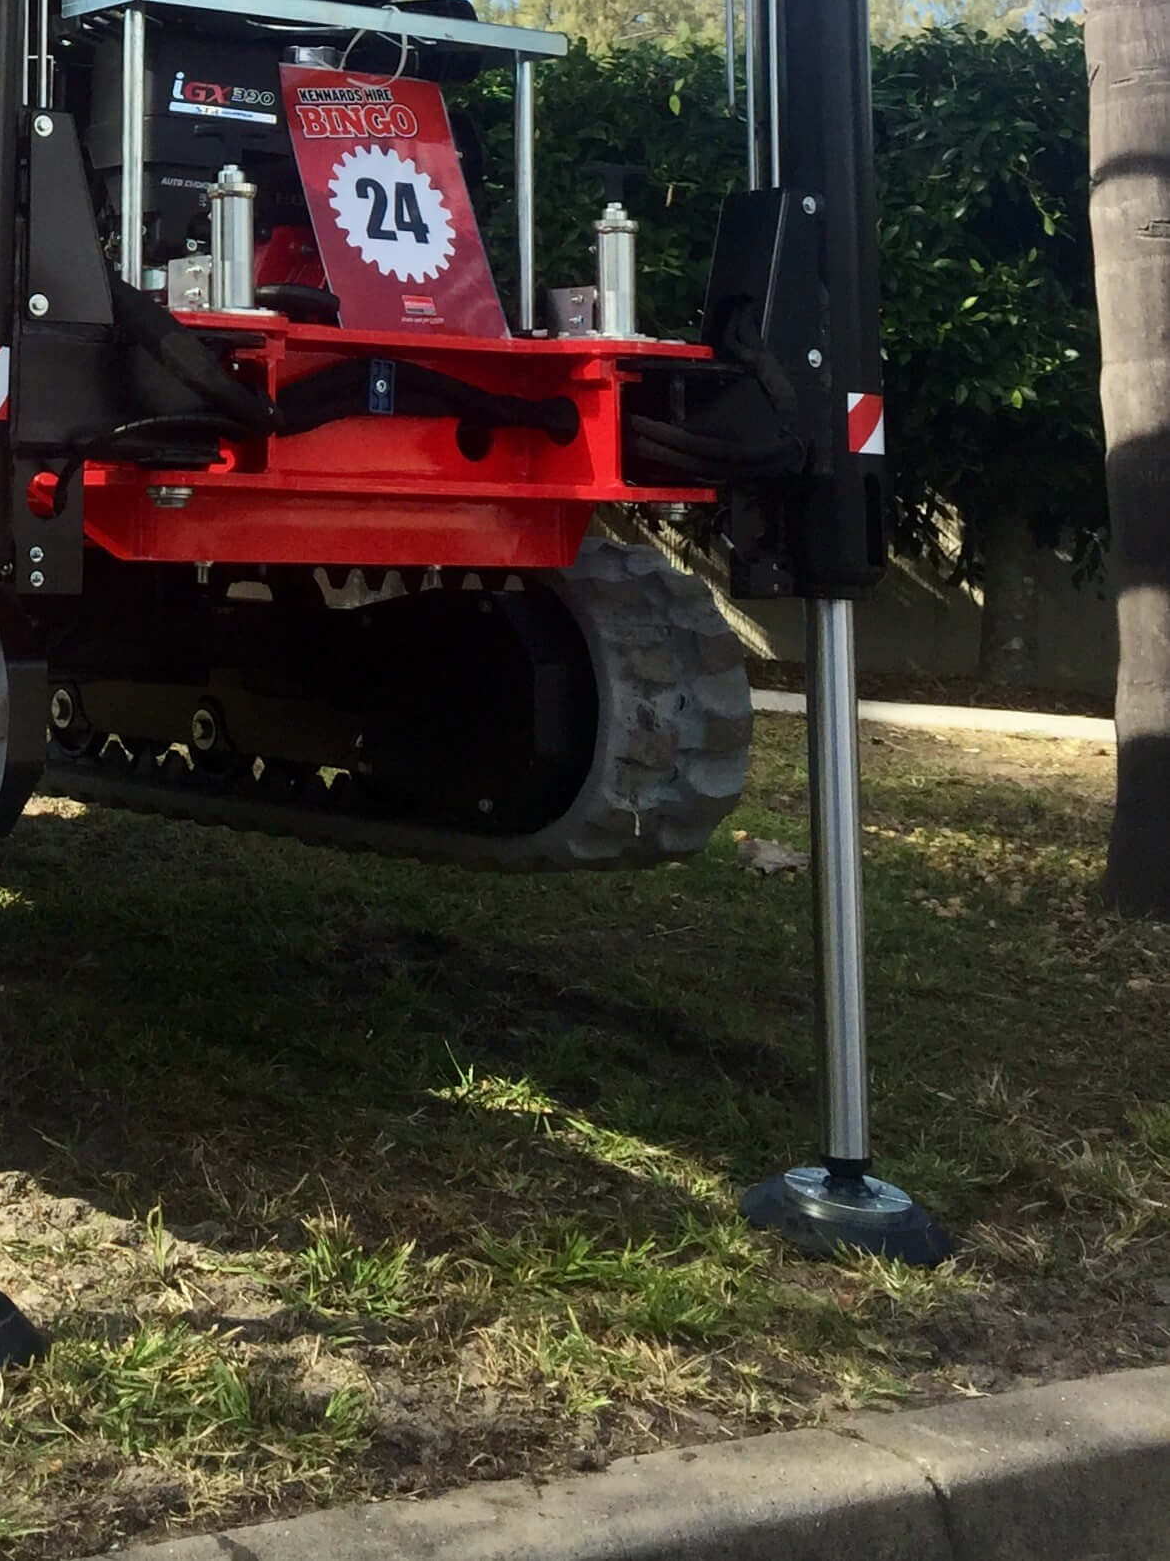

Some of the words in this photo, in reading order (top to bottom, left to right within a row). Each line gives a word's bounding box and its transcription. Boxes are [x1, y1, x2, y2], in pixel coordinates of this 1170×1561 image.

[297, 88, 362, 103] KENNARDS
[364, 88, 393, 103] HIRE
[295, 104, 418, 138] BINGO
[356, 178, 429, 244] 24
